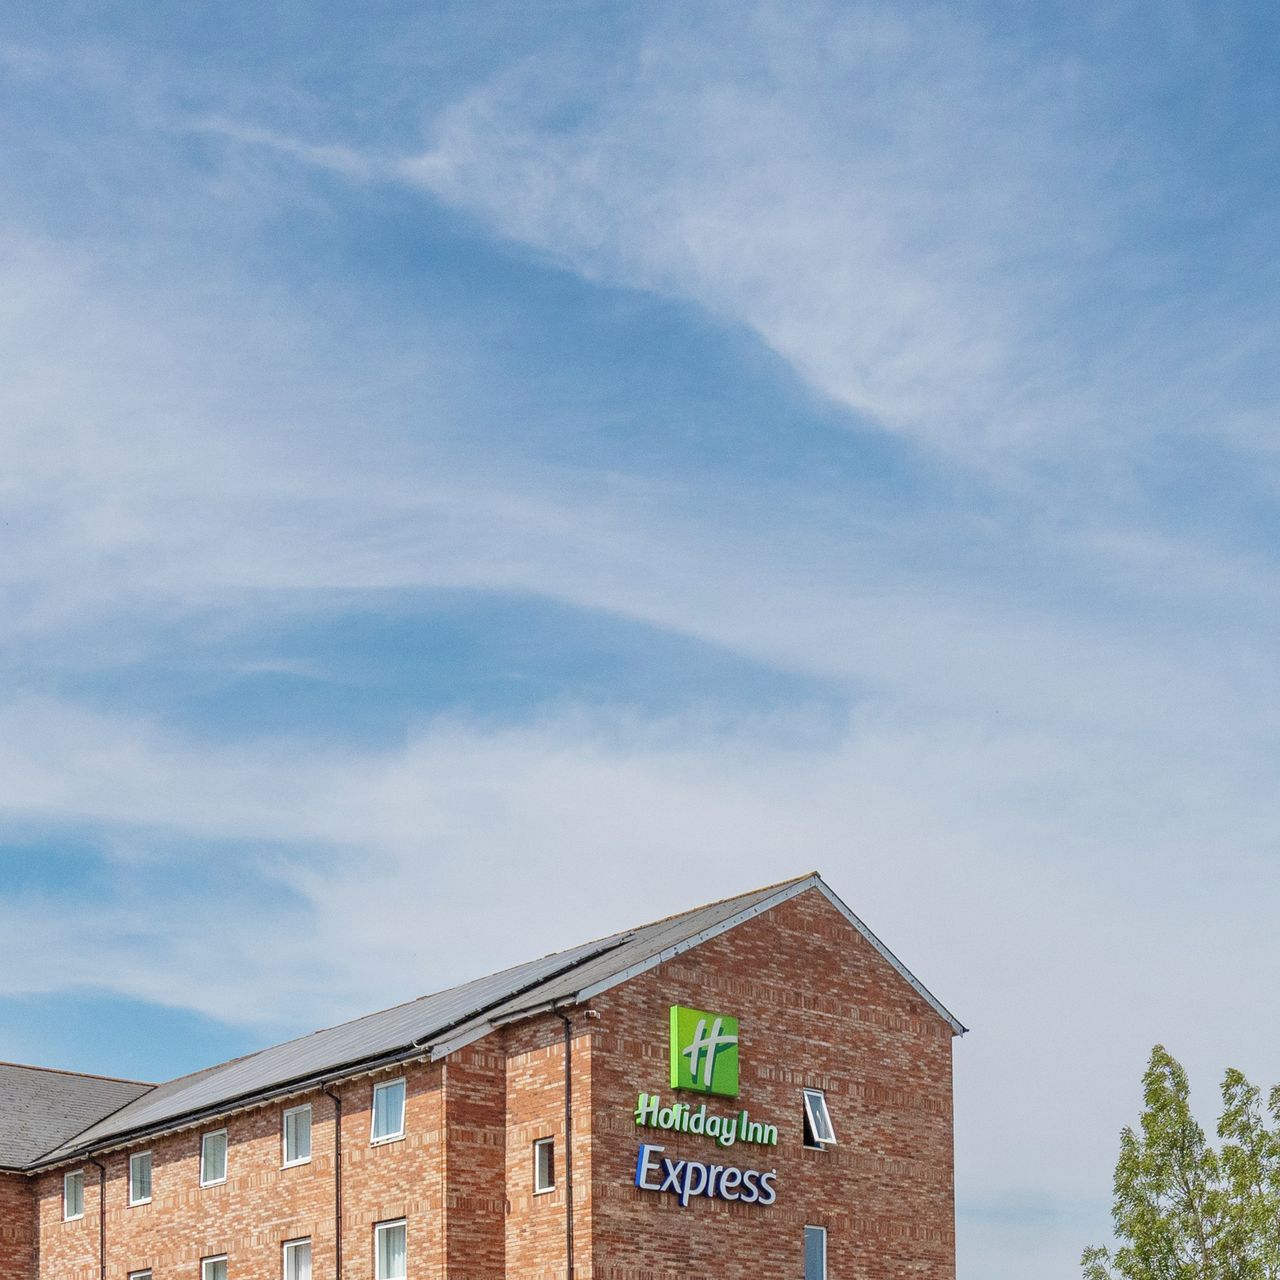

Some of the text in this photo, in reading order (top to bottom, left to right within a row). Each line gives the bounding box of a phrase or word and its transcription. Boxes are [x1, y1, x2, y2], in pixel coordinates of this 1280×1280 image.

[634, 1093, 778, 1146] Holiday Inn
[635, 1143, 777, 1207] Express
